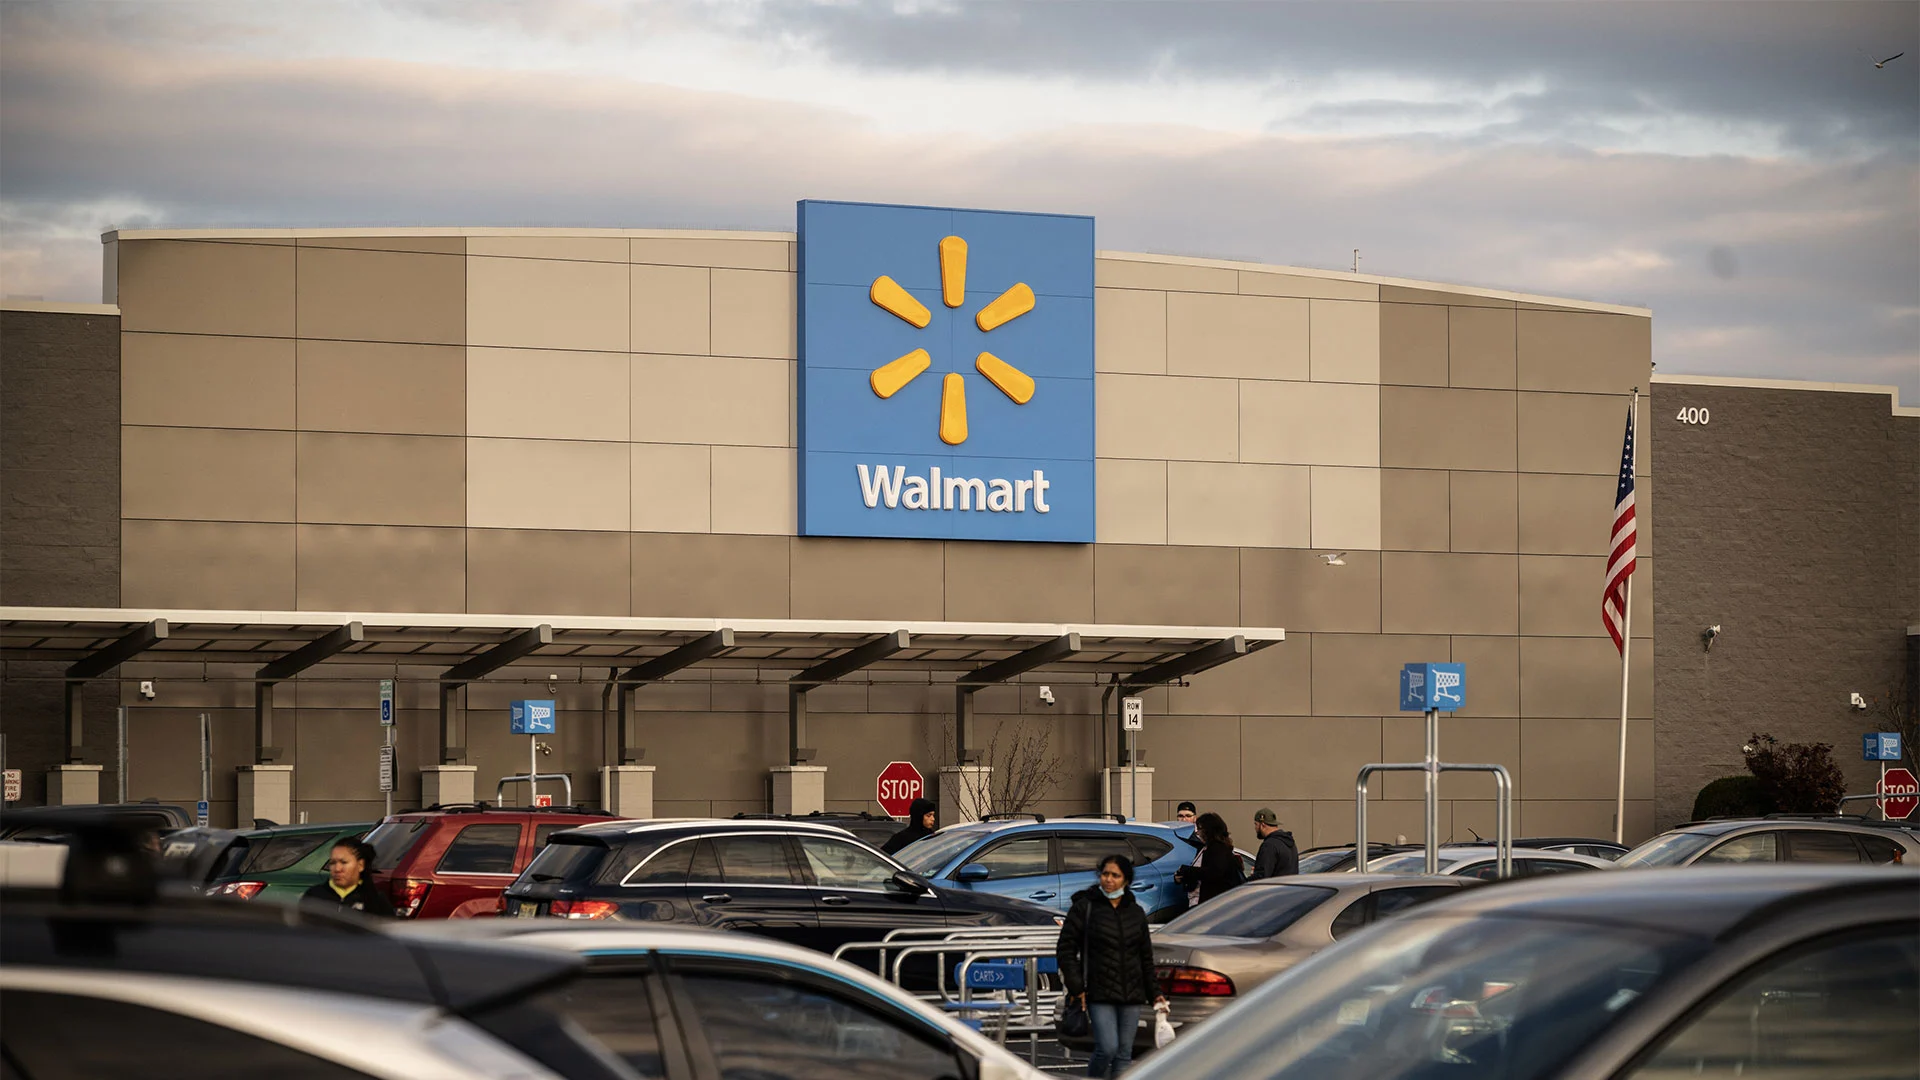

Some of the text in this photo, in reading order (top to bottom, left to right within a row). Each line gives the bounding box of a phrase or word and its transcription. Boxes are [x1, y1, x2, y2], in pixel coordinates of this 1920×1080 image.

[1676, 406, 1710, 425] 400
[857, 464, 1050, 513] Walmart
[1126, 702, 1140, 710] ROW
[1128, 713, 1138, 726] 14
[880, 779, 920, 800] STOP
[973, 970, 995, 982] CARTS
